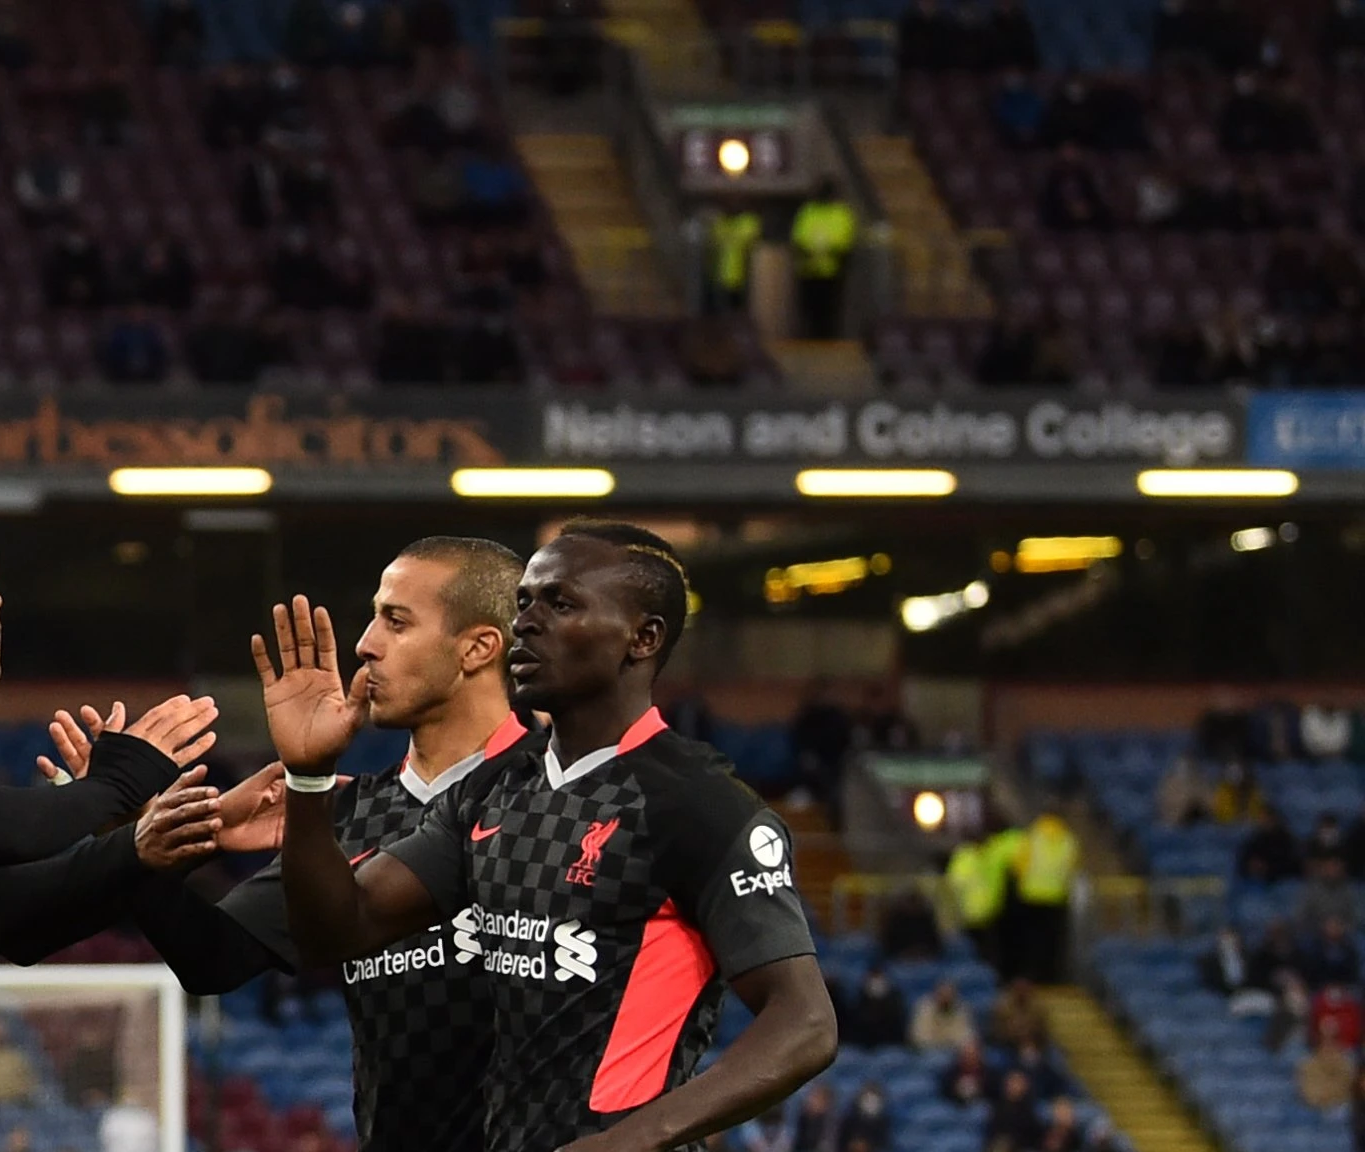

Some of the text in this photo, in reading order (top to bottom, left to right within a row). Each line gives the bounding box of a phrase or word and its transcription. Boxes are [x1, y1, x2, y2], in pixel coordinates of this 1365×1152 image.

[542, 403, 732, 457] Nelson
[742, 403, 846, 457] and
[1026, 403, 1234, 466] College
[471, 903, 550, 942] Standard
